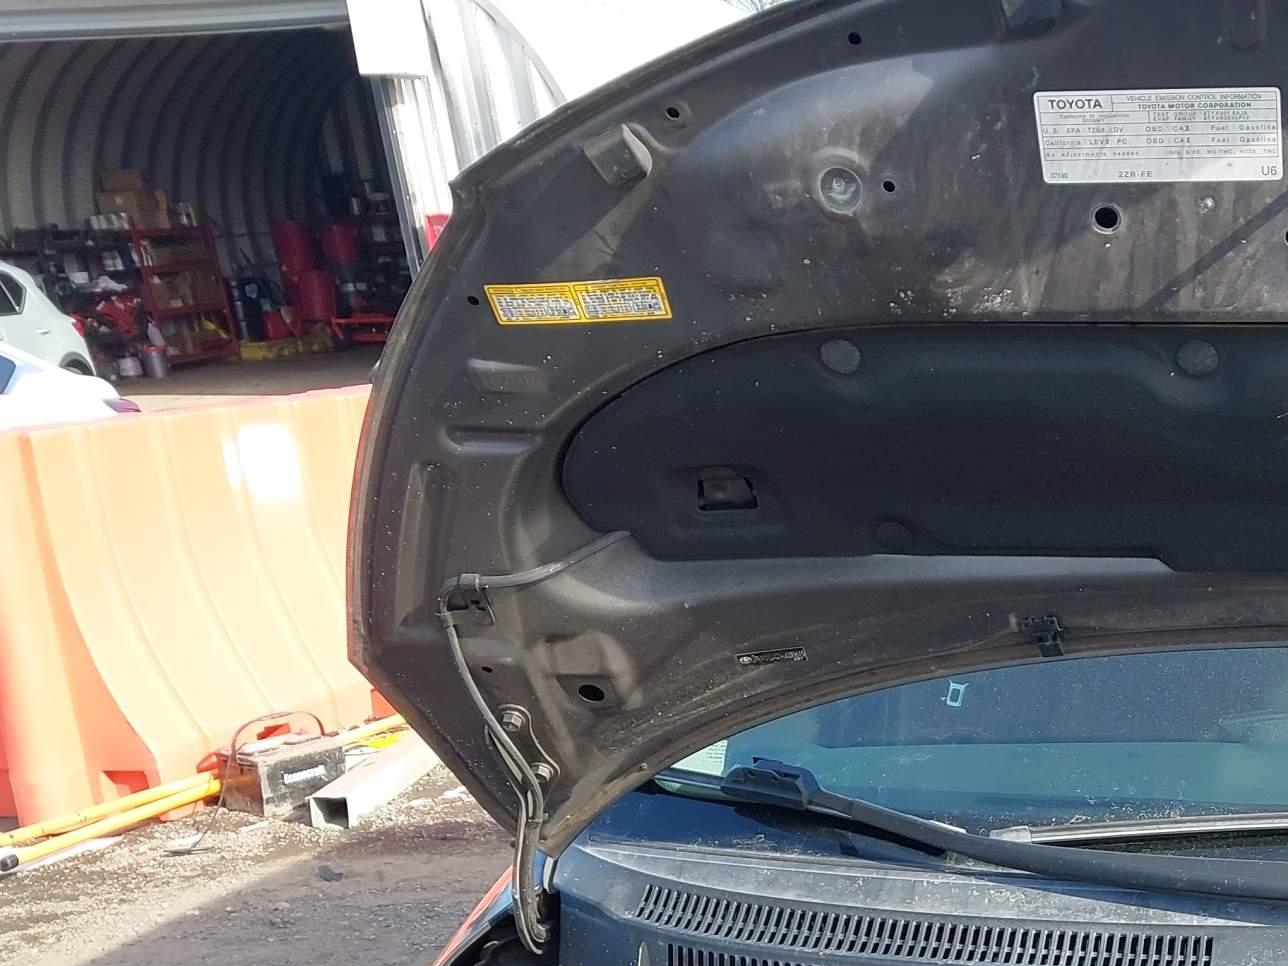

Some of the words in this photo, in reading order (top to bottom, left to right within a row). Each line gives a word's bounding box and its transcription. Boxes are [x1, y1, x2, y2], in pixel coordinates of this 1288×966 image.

[1048, 98, 1102, 110] TOYOTA
[1198, 101, 1252, 109] CORPORATION
[1117, 170, 1153, 178] 2ZR-FE
[1261, 165, 1278, 176] U6
